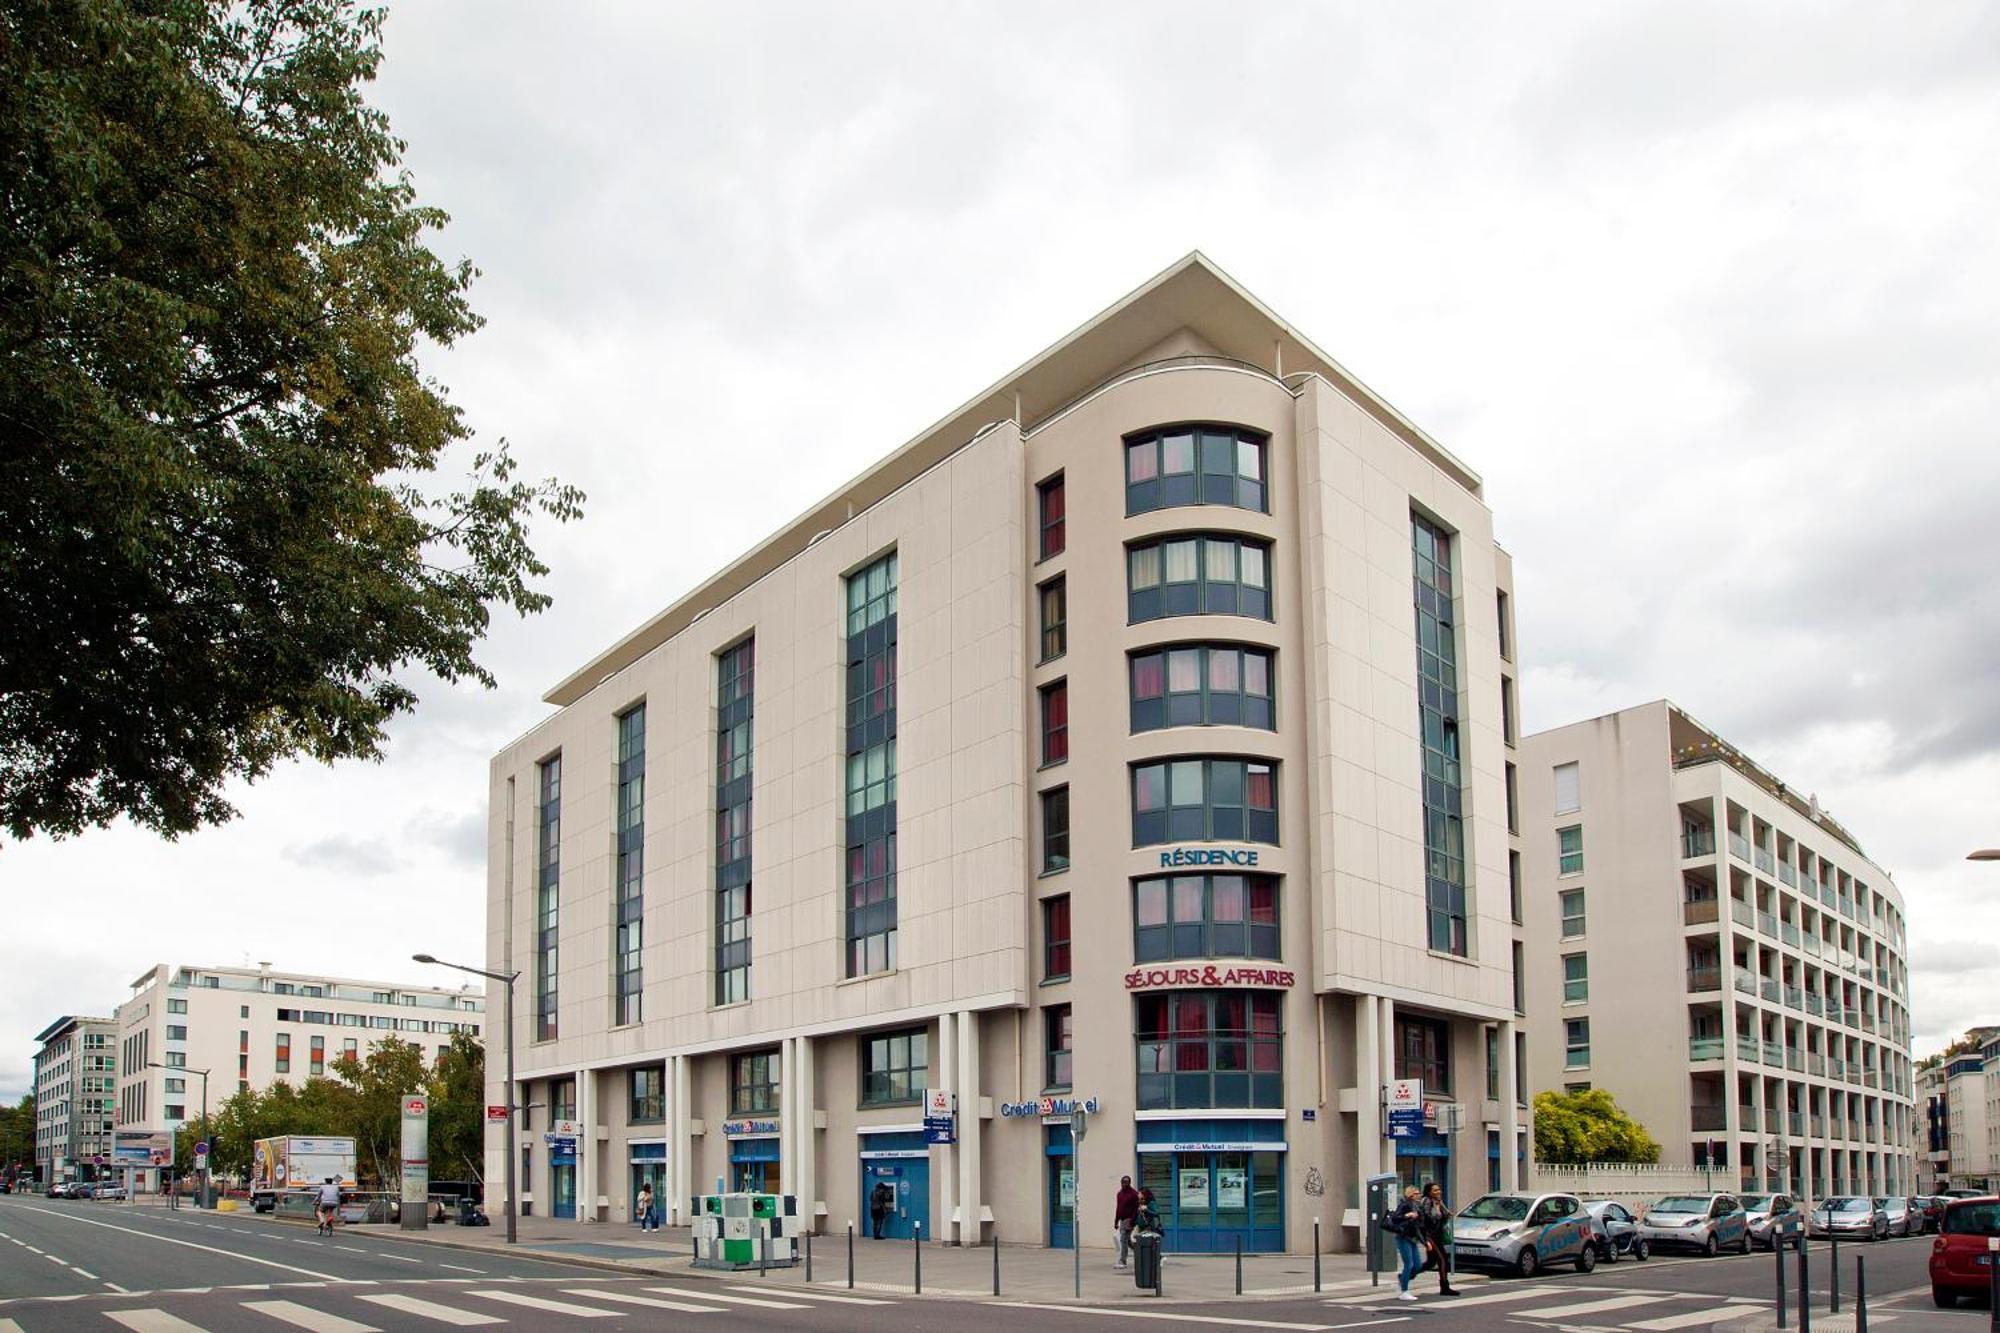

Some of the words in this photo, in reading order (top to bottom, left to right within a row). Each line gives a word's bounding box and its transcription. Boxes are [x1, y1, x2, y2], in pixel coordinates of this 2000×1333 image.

[1160, 848, 1258, 867] RÉSIDENCE
[1125, 969, 1200, 989] SÉJOURS
[1223, 969, 1295, 987] AFFAIRES
[1001, 1101, 1039, 1118] Crédit
[1052, 1097, 1098, 1115] Mutel
